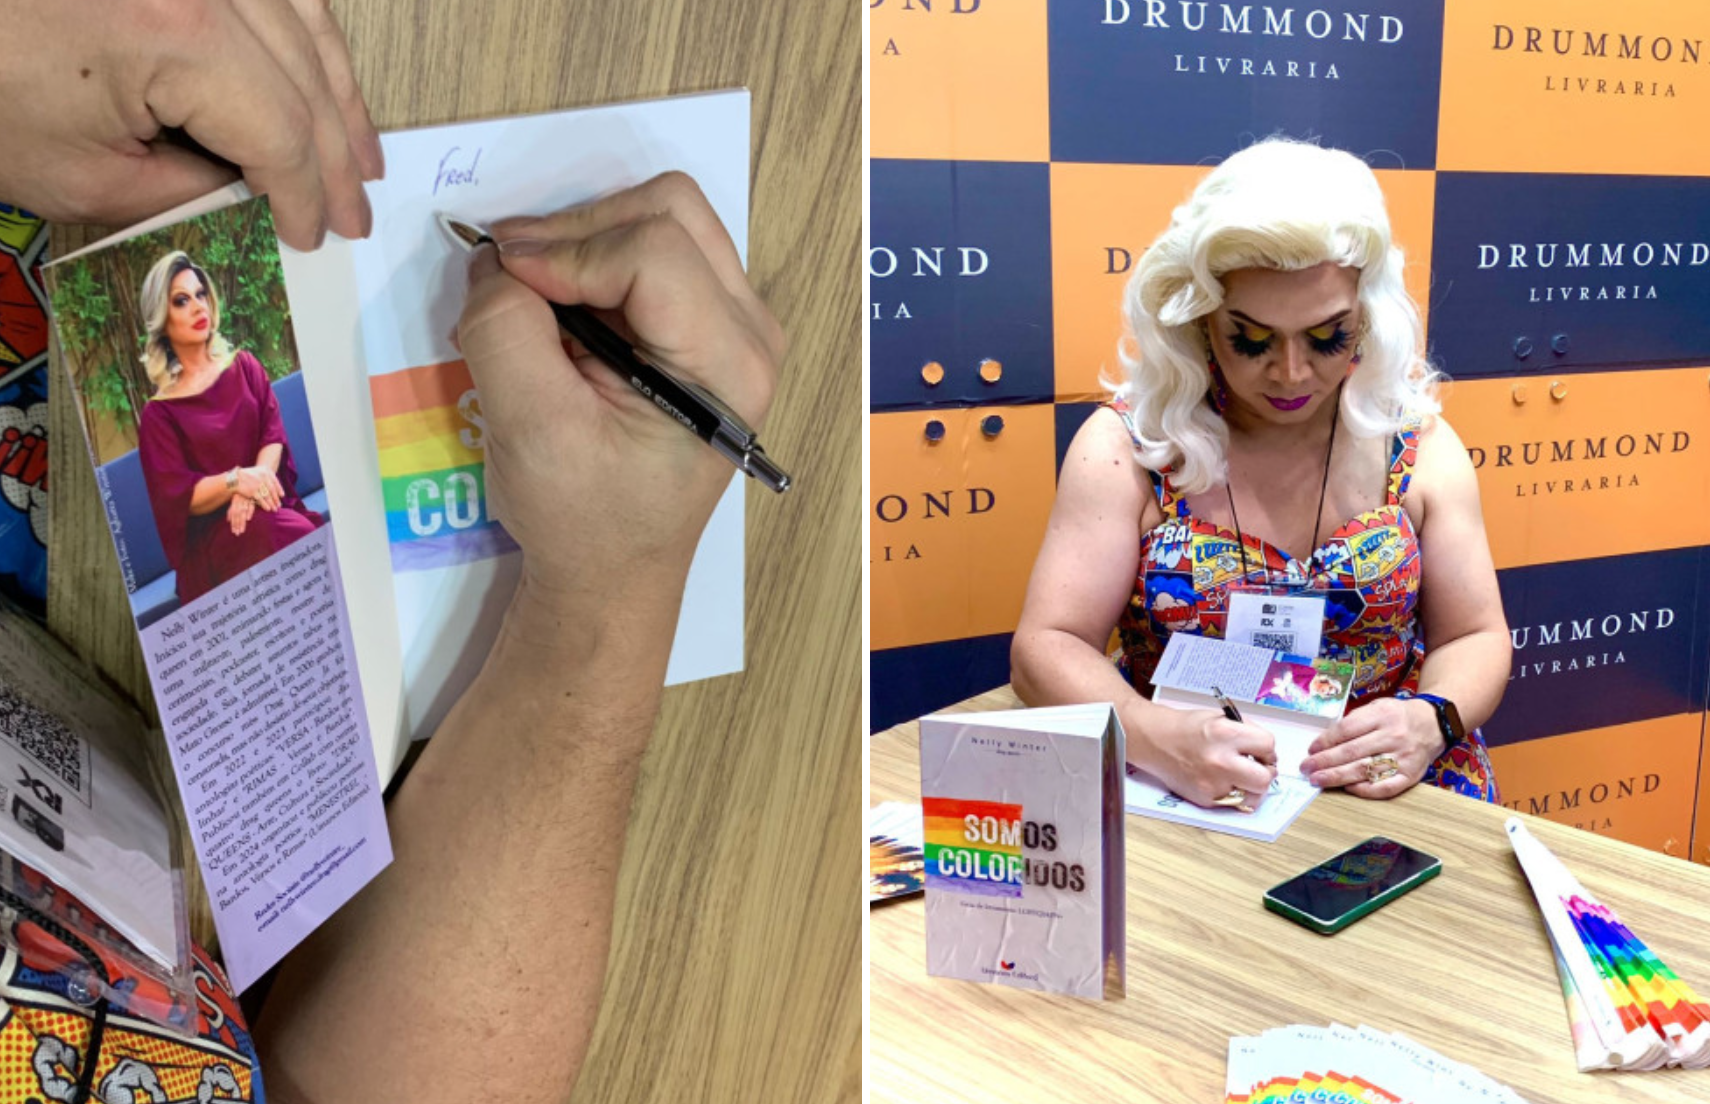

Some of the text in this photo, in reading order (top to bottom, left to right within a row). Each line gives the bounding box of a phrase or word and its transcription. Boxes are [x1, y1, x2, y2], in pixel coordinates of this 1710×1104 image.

[1101, 0, 1404, 43] DRUMMOND
[1492, 24, 1710, 64] DRUMMON
[1175, 54, 1339, 79] LIVRARIA
[1545, 75, 1676, 97] LIVRARIA
[1477, 242, 1710, 269] DRUMMOND
[1529, 285, 1658, 302] LIVRARIA
[631, 375, 698, 434] ELO EDITORA
[1466, 430, 1690, 469] DRUMMOND
[1516, 473, 1640, 497] LIVRARIA
[153, 640, 187, 664] Iniciou
[191, 628, 207, 642] sua
[284, 568, 307, 586] como
[160, 621, 185, 642] Nelly
[187, 602, 219, 624] Winter
[231, 584, 251, 600] uma
[299, 617, 306, 626] e
[1510, 607, 1675, 650] UMMOND
[159, 658, 188, 680] queen
[188, 648, 203, 661] em
[230, 606, 271, 636] animando
[294, 588, 300, 596] e
[1508, 650, 1626, 681] IVRARIA
[162, 678, 185, 696] uma
[213, 685, 228, 699] em
[220, 695, 238, 711] Sua
[274, 663, 285, 675] de
[178, 736, 203, 757] Mato
[280, 673, 295, 687] Em
[182, 762, 191, 772] o
[197, 732, 234, 762] concurso
[263, 697, 284, 715] Drag
[247, 728, 264, 744] não
[971, 737, 1047, 752] Nelly Winter
[200, 778, 218, 794] Em
[224, 754, 247, 777] 2022
[253, 748, 259, 756] e
[265, 725, 287, 748] 2023
[232, 796, 238, 804] e
[316, 733, 322, 742] e
[194, 779, 239, 815] antologias
[201, 810, 241, 843] Publicou
[241, 784, 276, 813] também
[276, 773, 290, 787] em
[204, 832, 234, 857] quatro
[239, 812, 259, 831] drag
[263, 788, 292, 813] queens
[295, 779, 303, 787] o
[964, 814, 1057, 851] SOMOS
[207, 831, 252, 871] QUEENS
[221, 862, 238, 877] Em
[239, 842, 259, 864] 2024
[299, 808, 305, 816] e
[276, 857, 282, 865] e
[215, 885, 228, 898] na
[233, 852, 269, 885] antologia
[938, 848, 1085, 892] COLORIDOS
